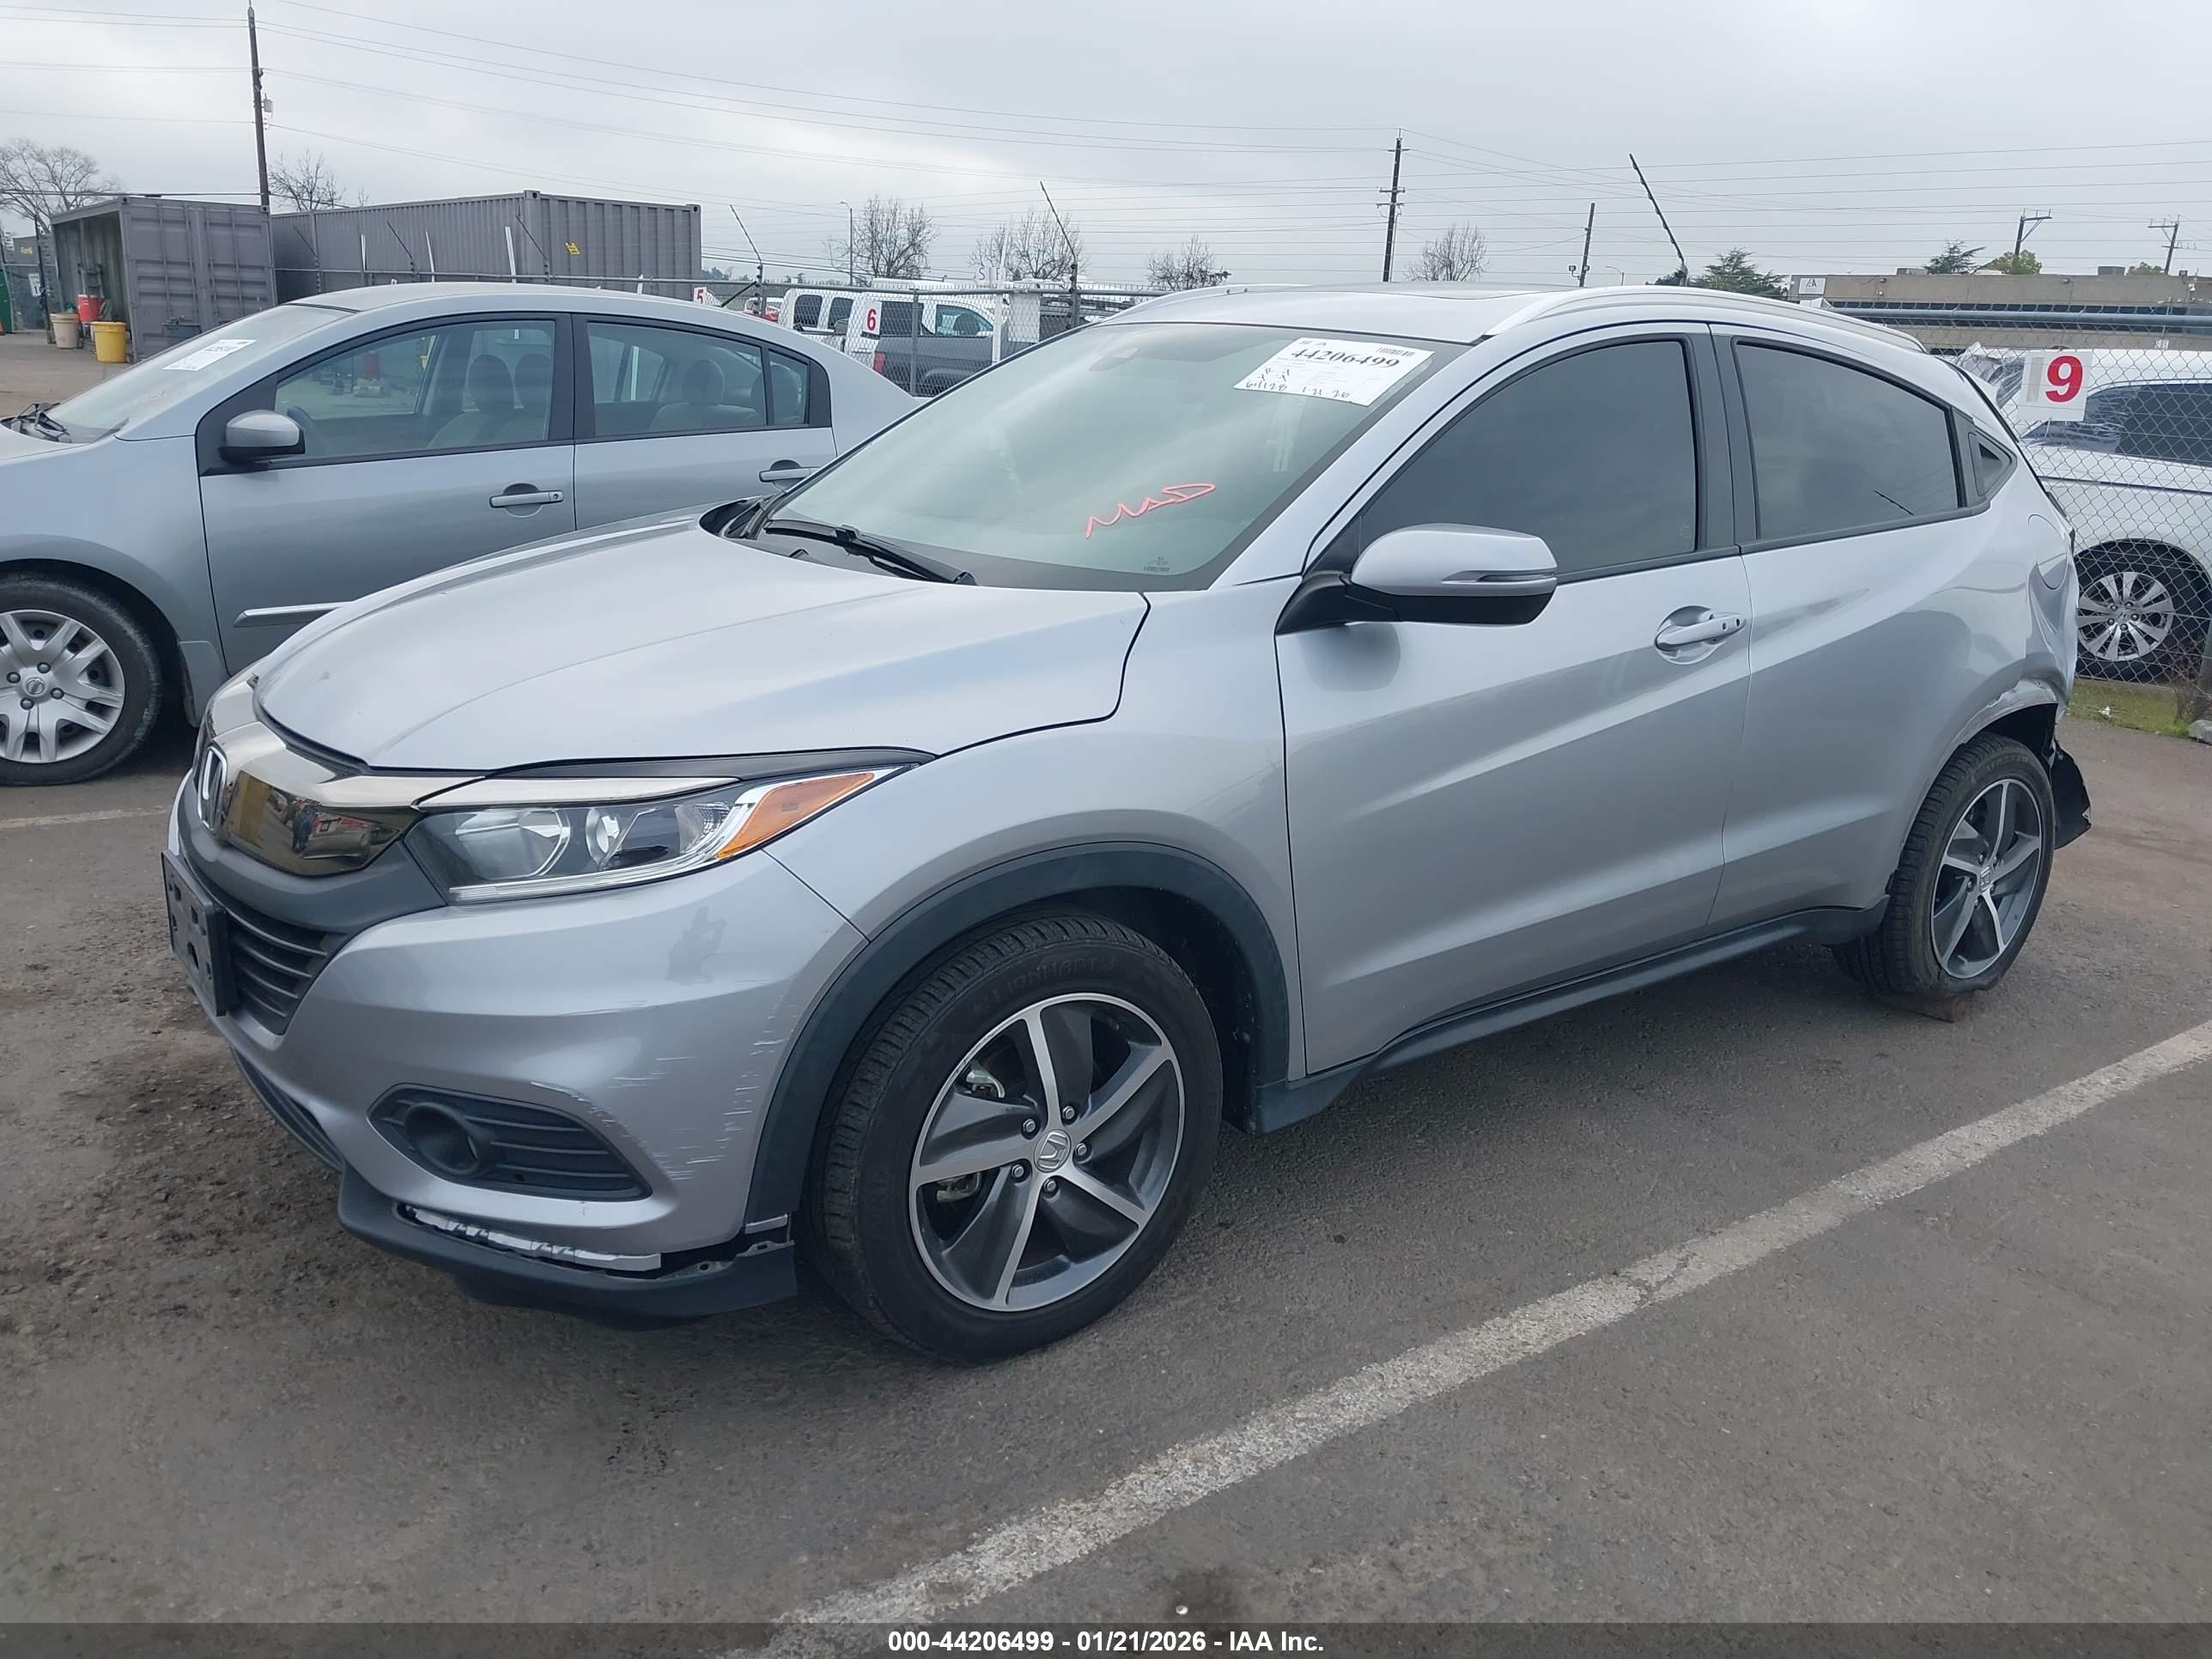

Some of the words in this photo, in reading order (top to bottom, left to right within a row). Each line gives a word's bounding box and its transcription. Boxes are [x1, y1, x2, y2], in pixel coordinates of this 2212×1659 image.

[867, 308, 877, 331] 6
[1291, 349, 1401, 368] 44206499
[2045, 356, 2083, 403] 9
